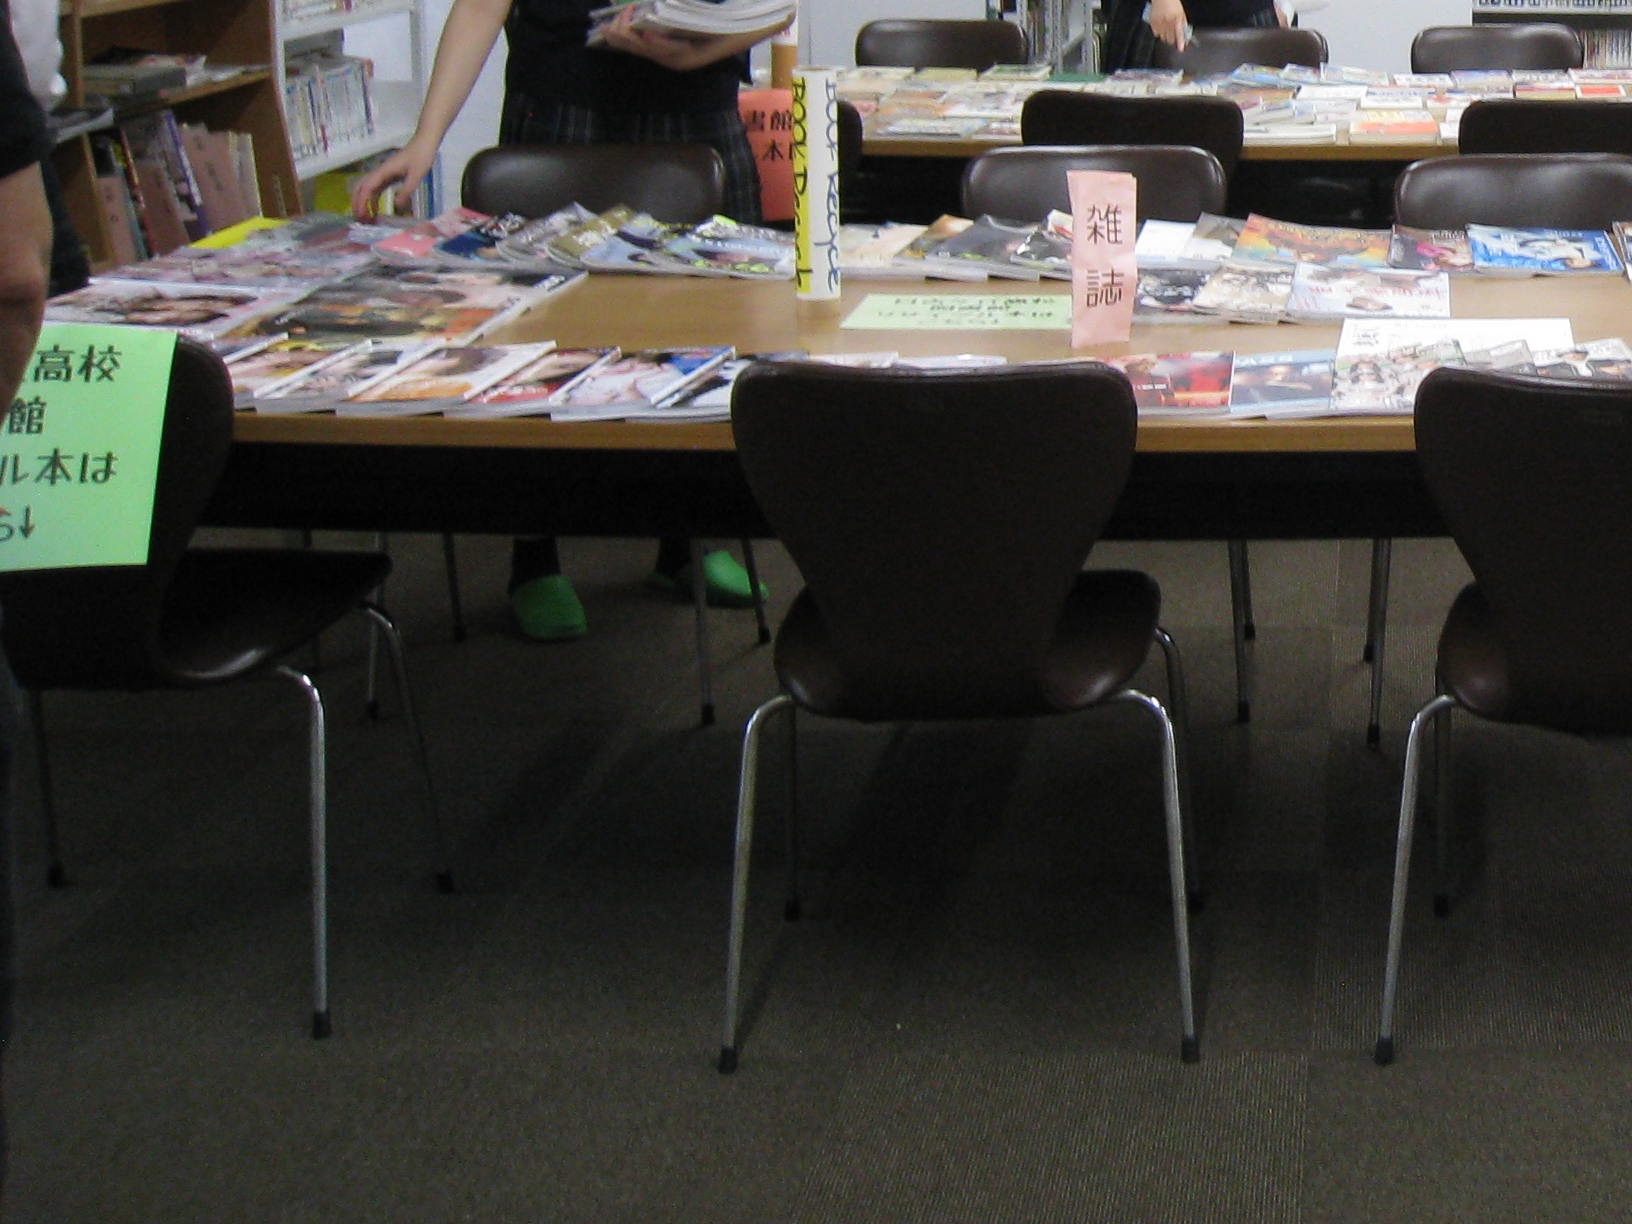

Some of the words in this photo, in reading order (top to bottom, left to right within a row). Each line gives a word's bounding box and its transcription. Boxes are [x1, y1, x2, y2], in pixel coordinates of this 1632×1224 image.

[1086, 203, 1125, 308] 雑誌
[22, 344, 122, 383] 高校
[0, 447, 120, 486] ル本は
